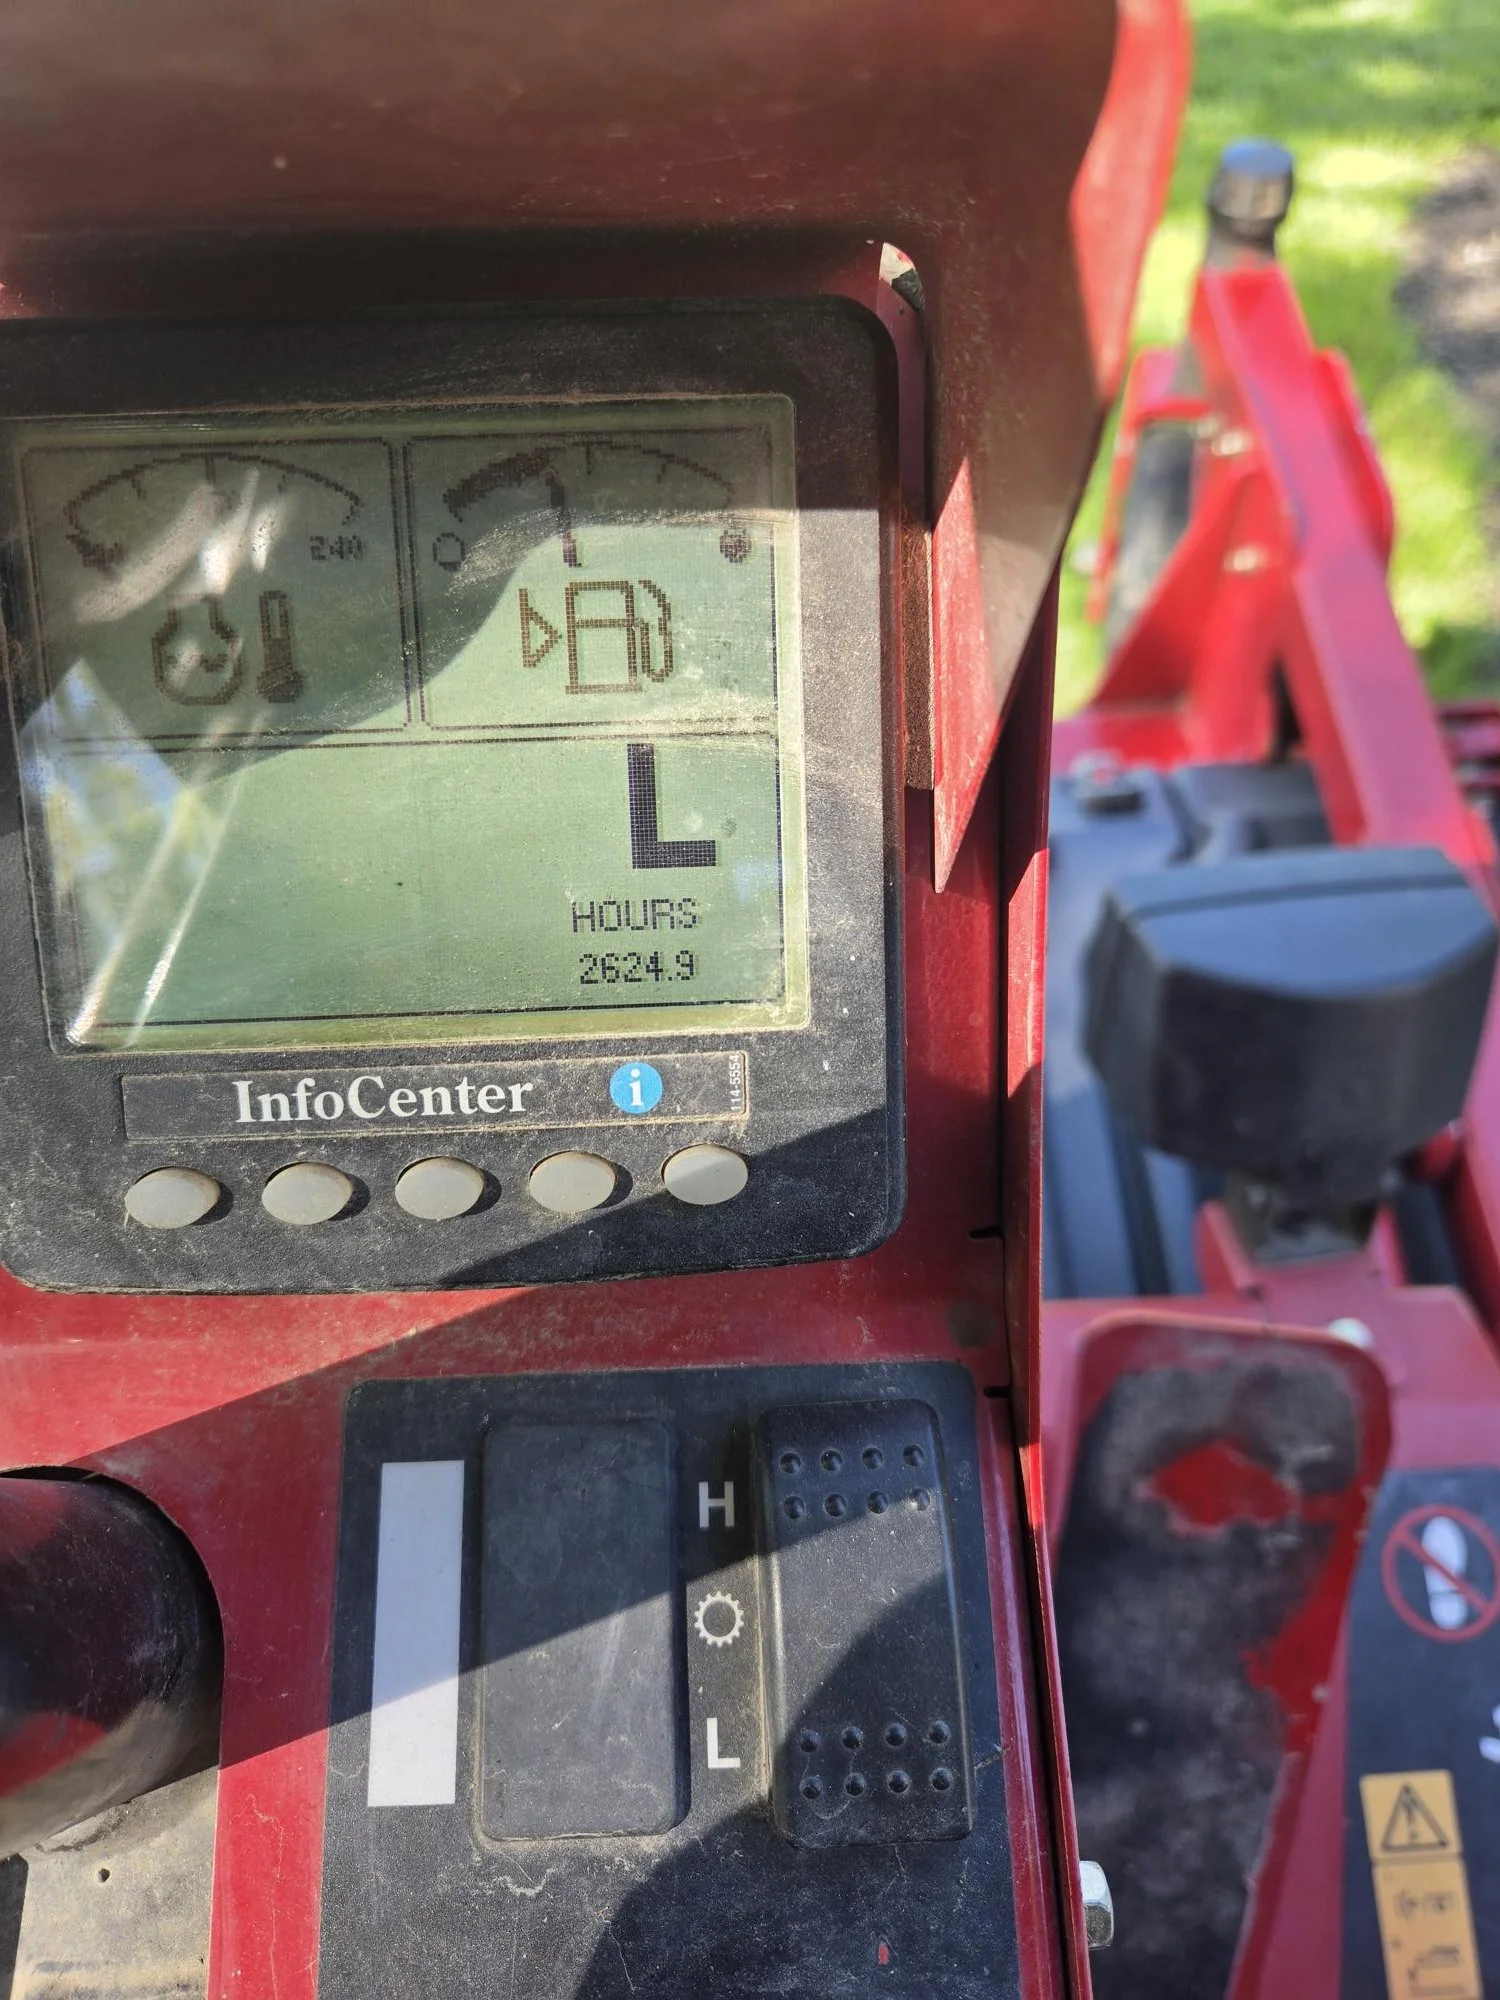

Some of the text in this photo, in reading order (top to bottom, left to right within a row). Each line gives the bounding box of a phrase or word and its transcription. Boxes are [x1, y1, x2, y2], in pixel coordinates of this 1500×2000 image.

[627, 743, 716, 869] L
[572, 898, 697, 933] HOURS
[579, 950, 697, 984] 2624.9
[233, 1075, 534, 1123] InfoCenter
[699, 1481, 735, 1527] H
[706, 1717, 741, 1769] L
